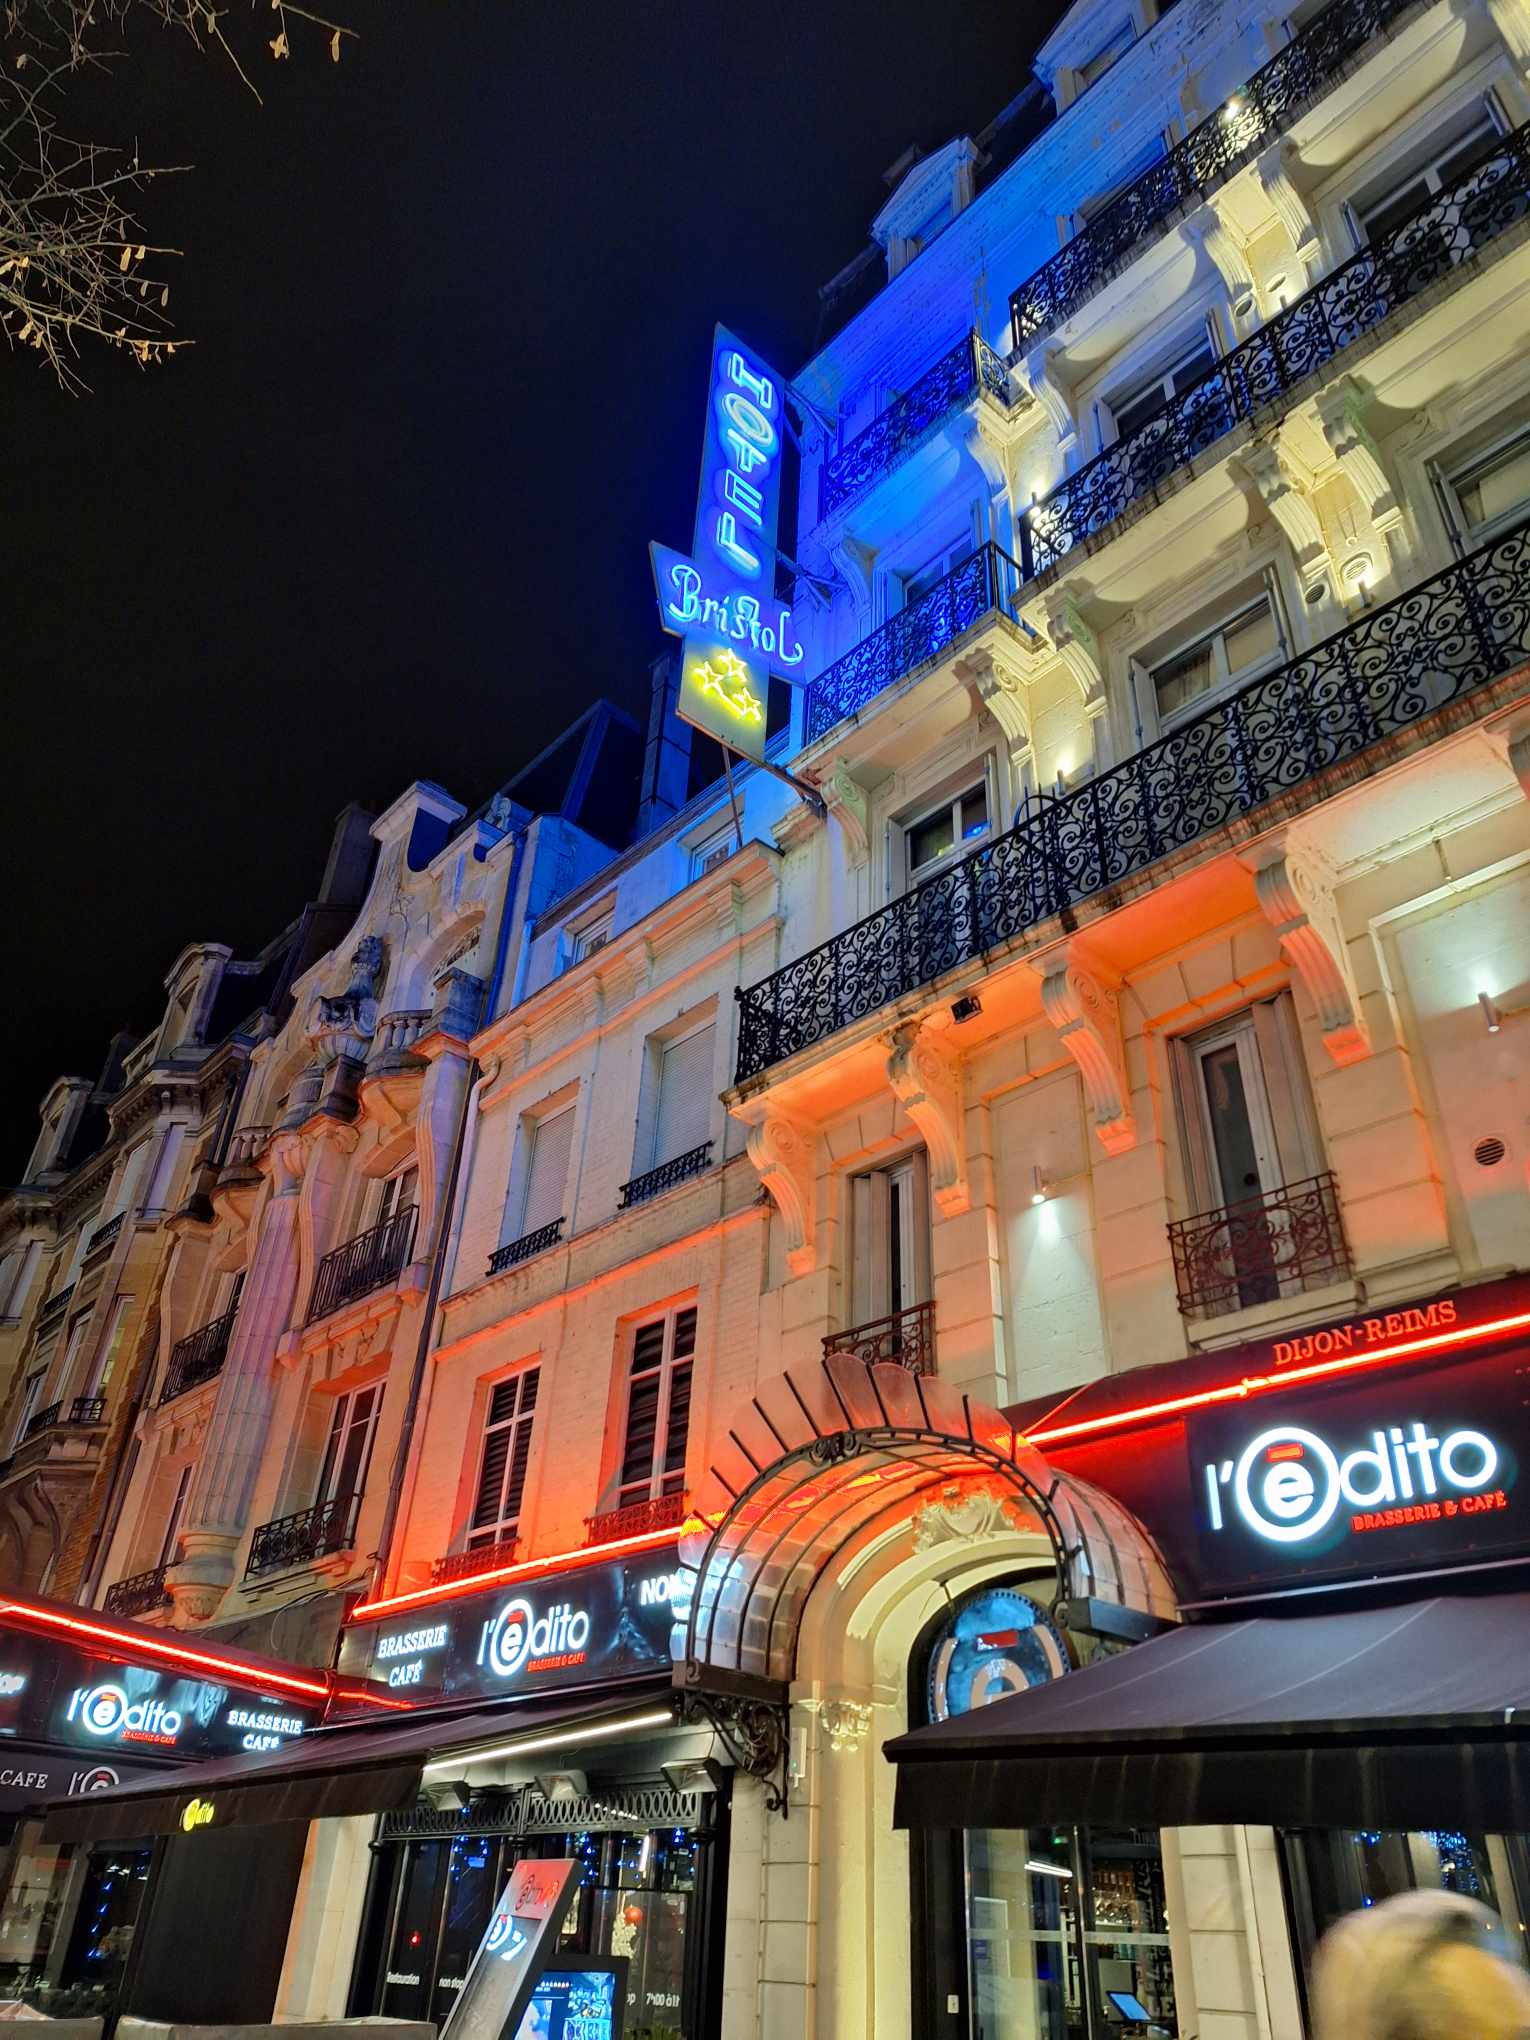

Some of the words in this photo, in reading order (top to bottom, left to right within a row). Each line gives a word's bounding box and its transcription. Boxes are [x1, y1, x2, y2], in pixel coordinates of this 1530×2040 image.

[716, 352, 774, 570] HOTEL
[668, 564, 804, 665] Bristol
[1273, 1300, 1457, 1365] DIJON-REIMS
[1351, 1503, 1441, 1531] BRASSERIE
[1444, 1499, 1459, 1516] &
[1461, 1490, 1507, 1513] CAFÉ
[377, 1625, 448, 1658] BRASSERIE
[389, 1658, 423, 1687] CAFÉ
[226, 1710, 303, 1734] BRASSERIE
